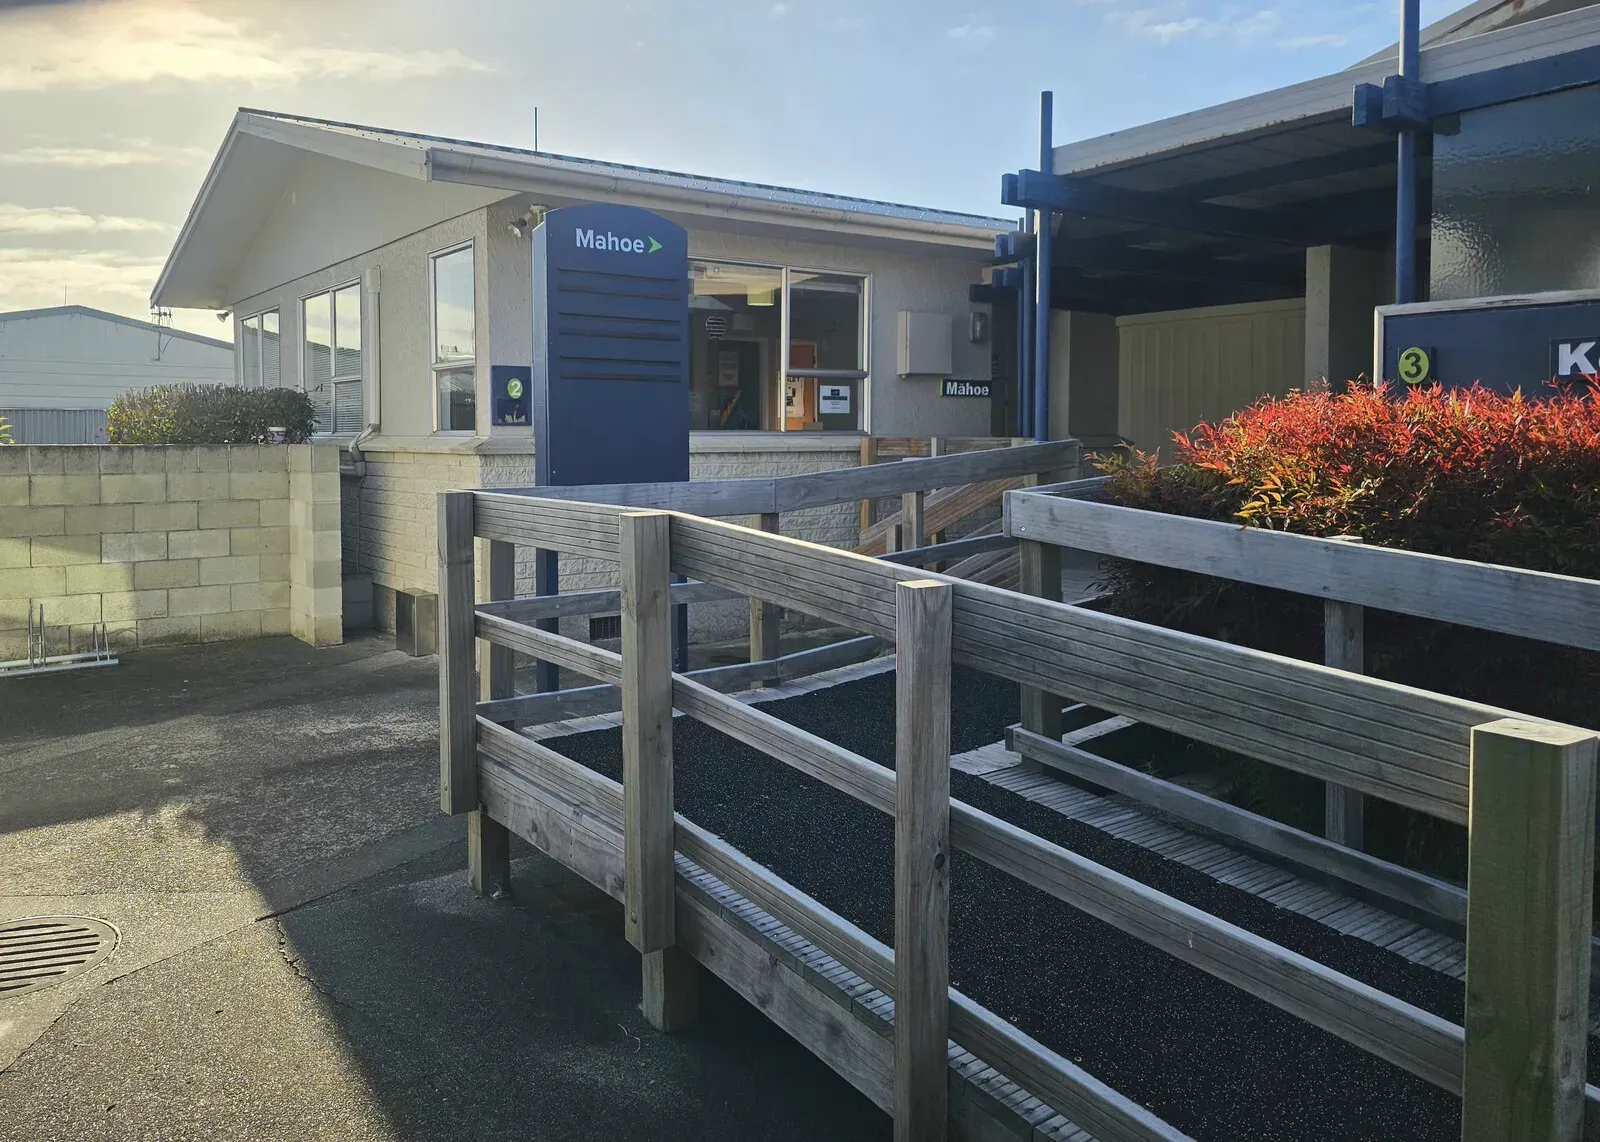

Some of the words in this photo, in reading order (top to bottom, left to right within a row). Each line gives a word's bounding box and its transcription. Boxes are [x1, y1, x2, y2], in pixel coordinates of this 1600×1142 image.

[575, 228, 644, 253] Mahoe
[1404, 352, 1422, 378] 3
[1558, 341, 1600, 375] K
[511, 380, 521, 396] 2
[946, 381, 989, 396] Māhoe
